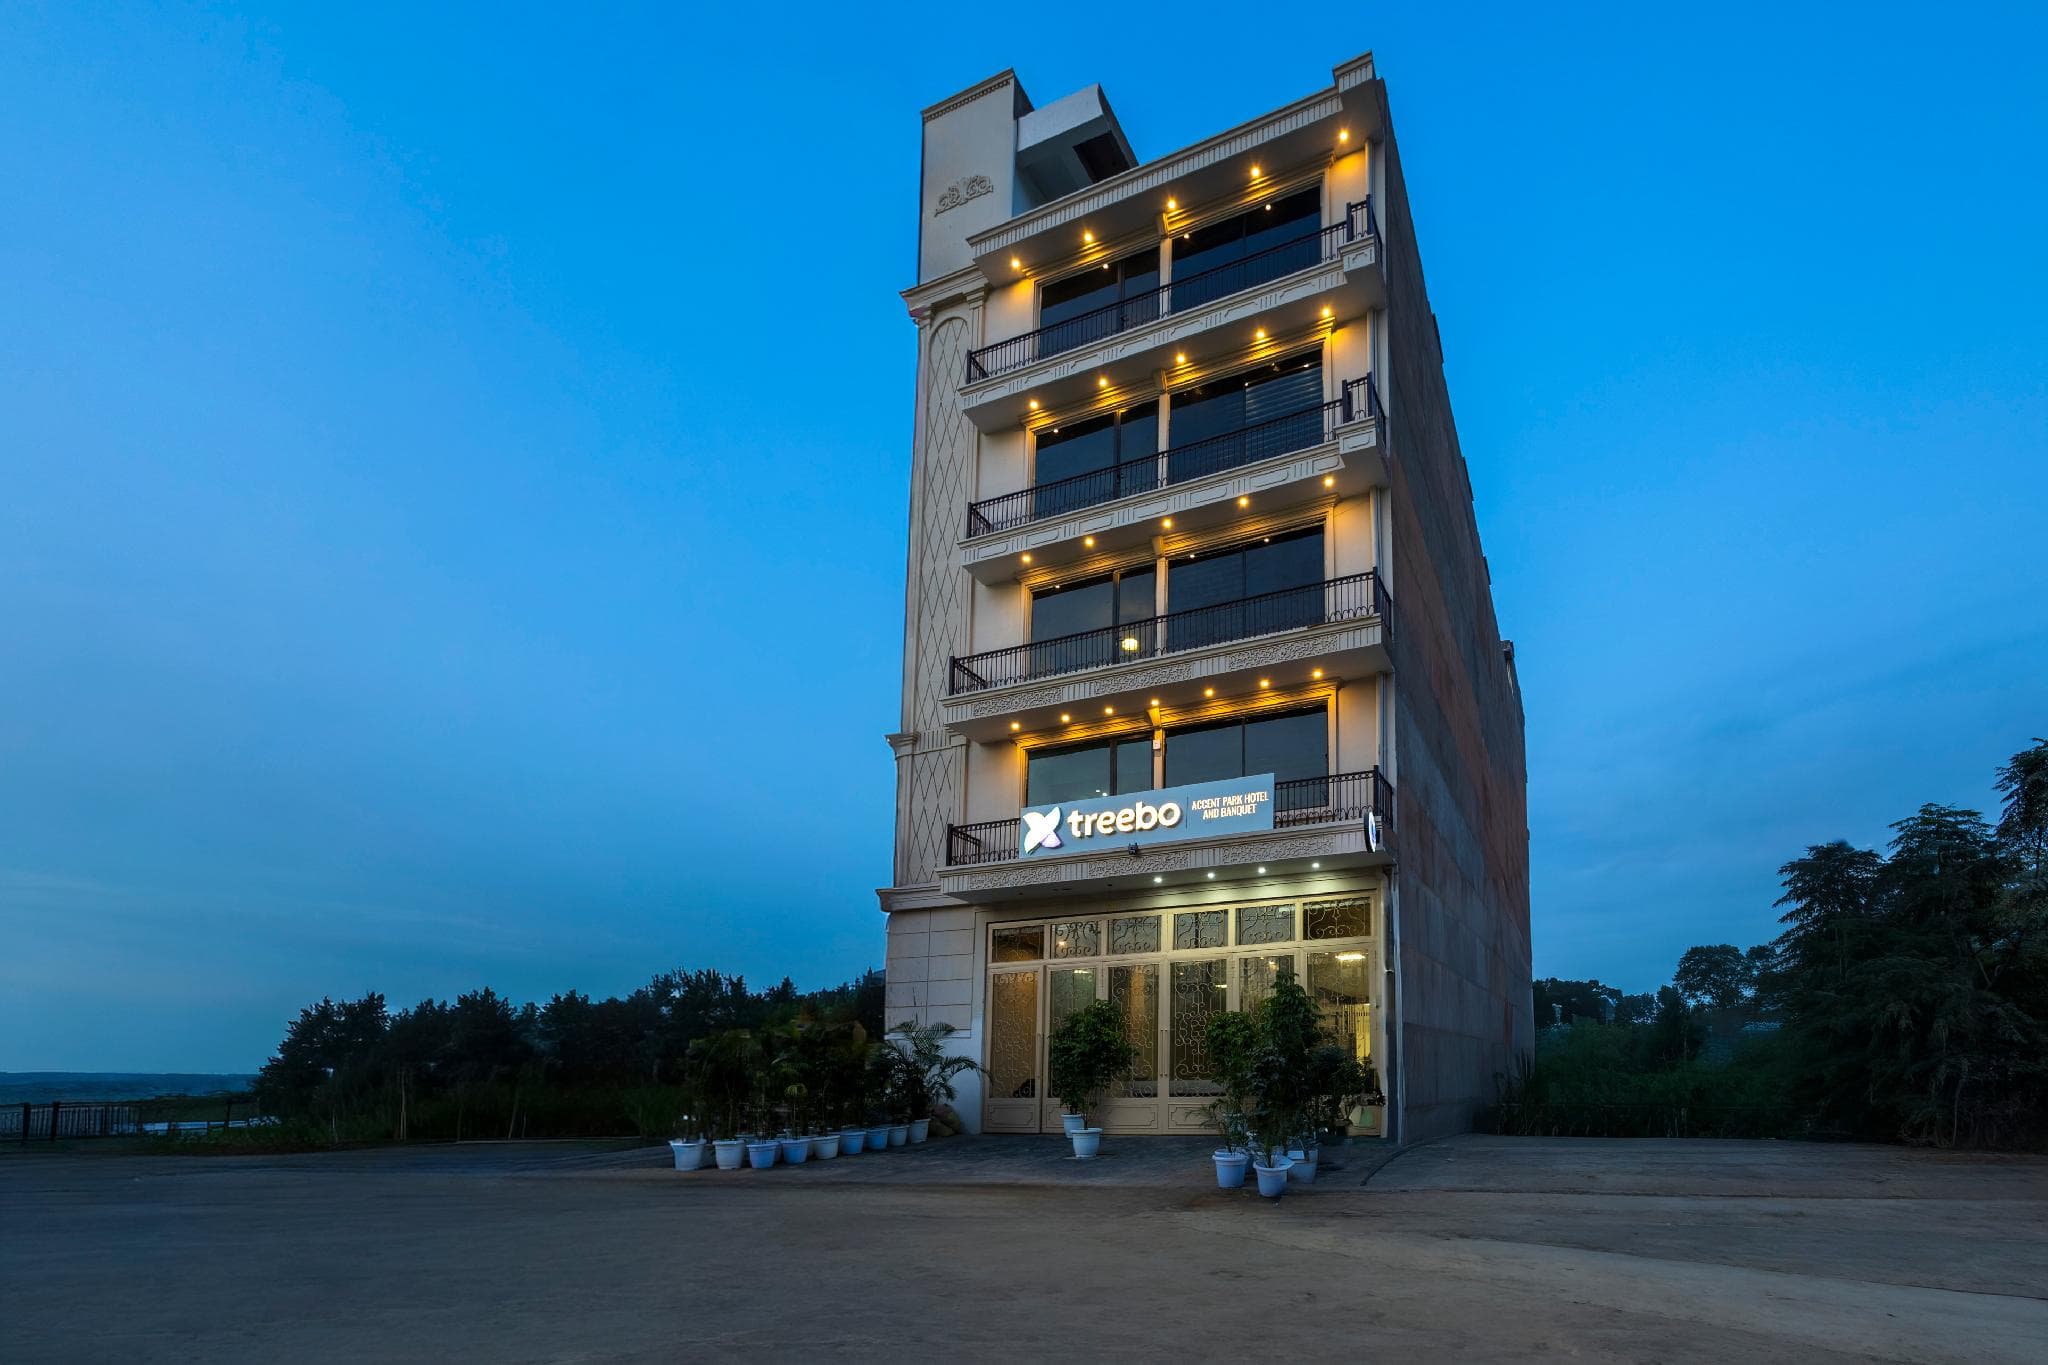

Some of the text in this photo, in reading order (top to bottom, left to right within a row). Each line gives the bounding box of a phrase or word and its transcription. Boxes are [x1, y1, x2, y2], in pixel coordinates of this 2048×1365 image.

[1191, 791, 1269, 810] ACCENT PARK HOTEL
[1067, 801, 1181, 838] treebo
[1202, 803, 1257, 820] AND BANQUET
